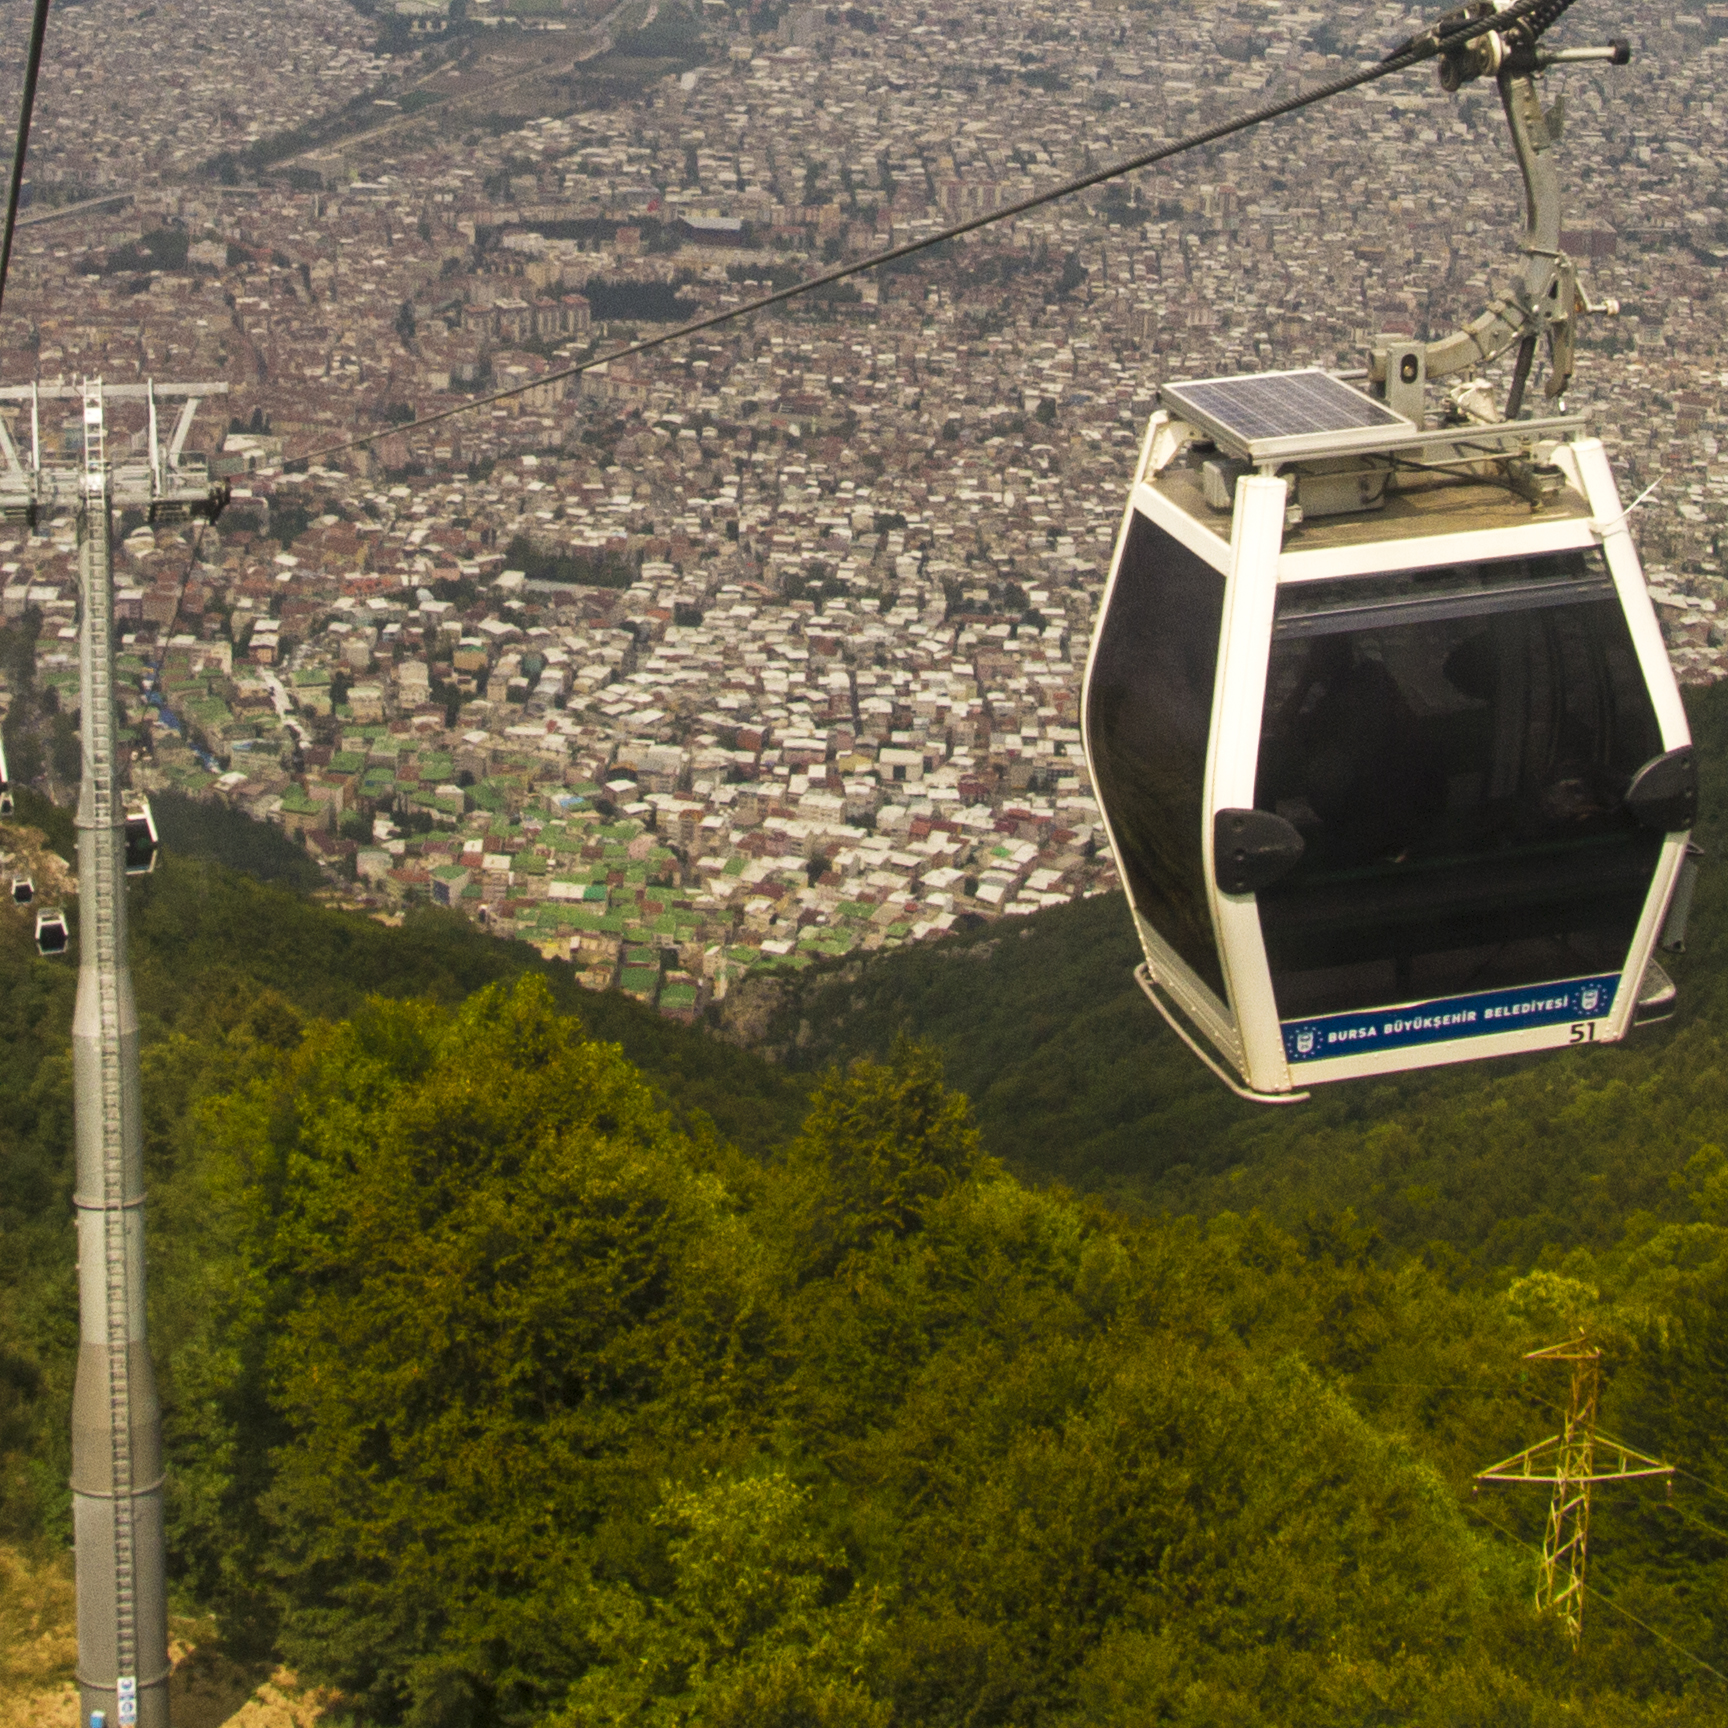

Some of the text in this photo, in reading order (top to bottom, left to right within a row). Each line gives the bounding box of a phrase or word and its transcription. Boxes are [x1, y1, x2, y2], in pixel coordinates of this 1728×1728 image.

[1328, 994, 1568, 1043] BURSA BÜYÜKŞEHİR BELEDİYESİ
[1570, 1022, 1595, 1043] 51
